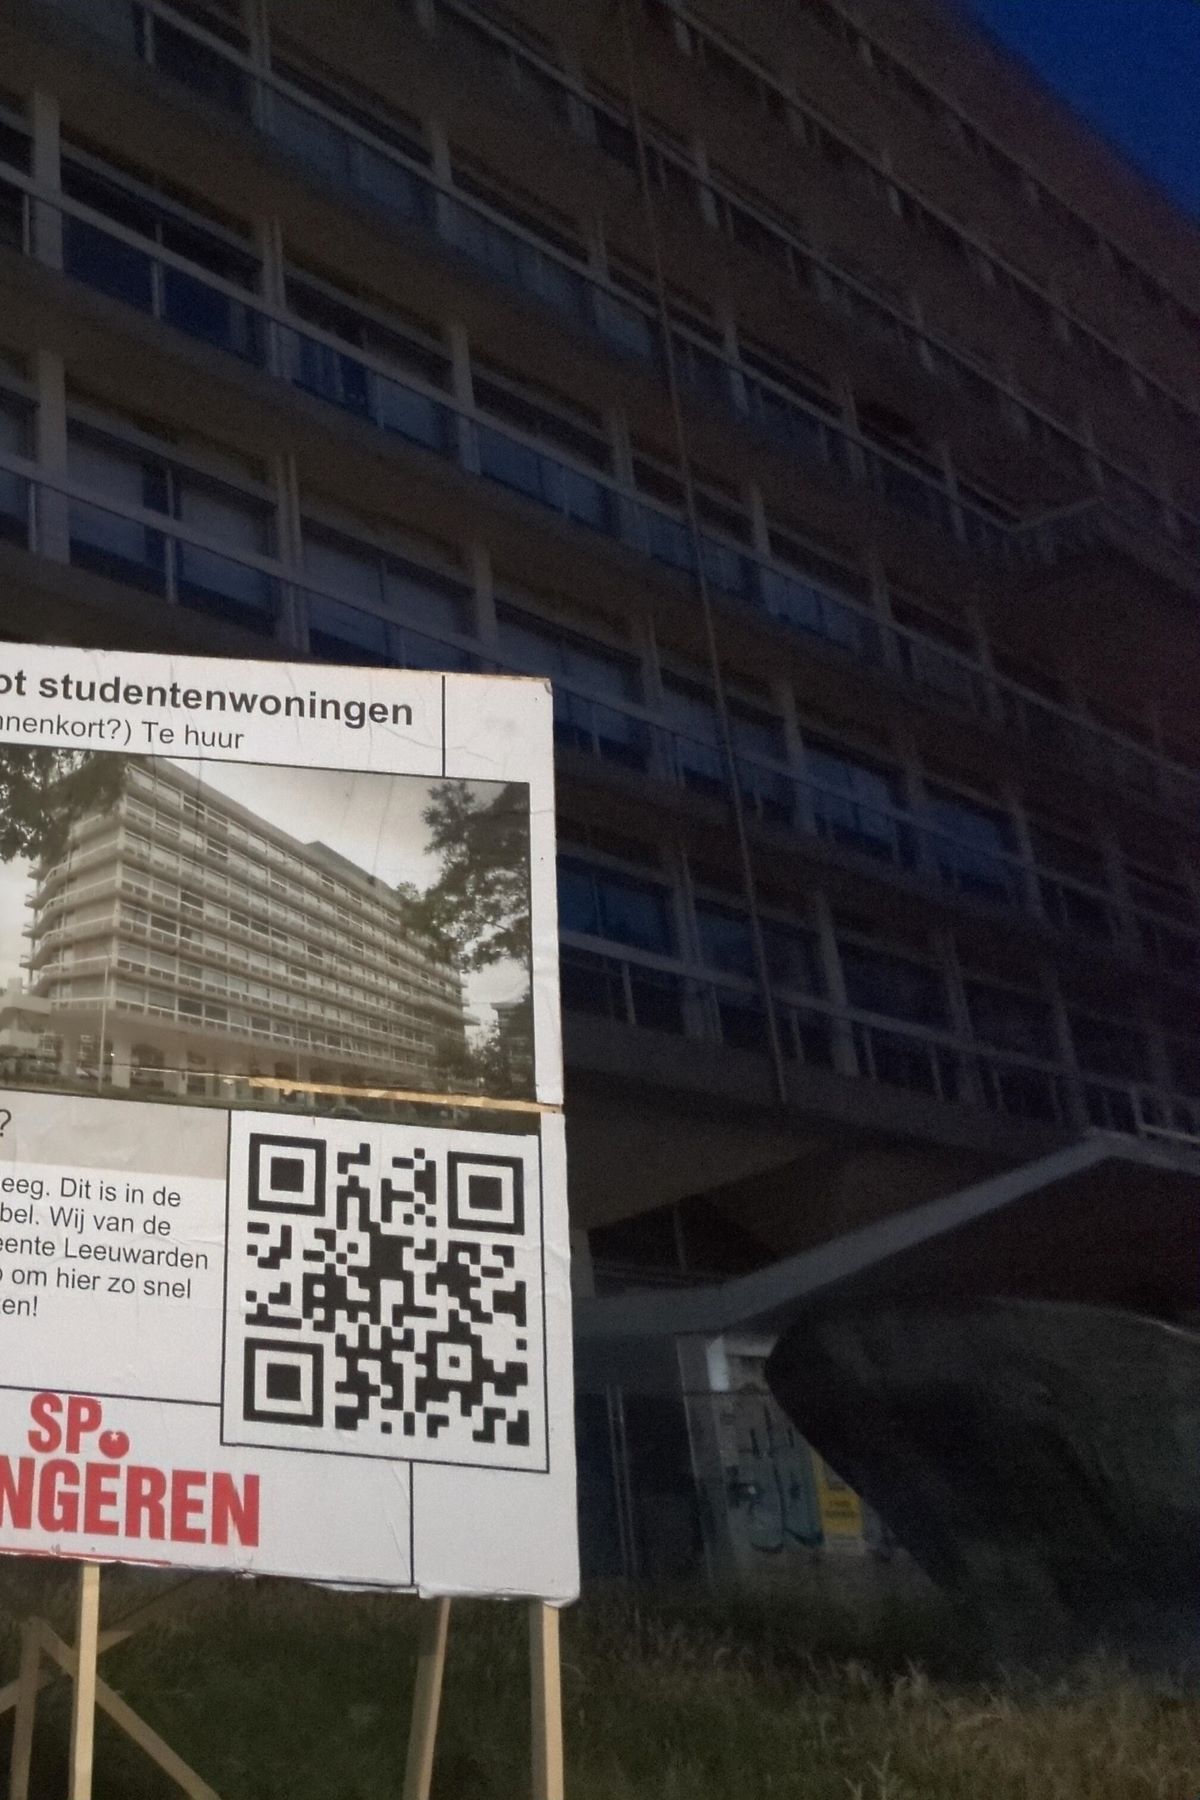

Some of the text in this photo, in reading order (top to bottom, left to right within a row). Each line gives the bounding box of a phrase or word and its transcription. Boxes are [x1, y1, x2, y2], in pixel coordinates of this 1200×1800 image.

[38, 673, 414, 730] studentenwoningen
[141, 720, 175, 745] Te
[184, 724, 245, 750] huur
[60, 1176, 92, 1200] Dit
[99, 1180, 117, 1202] is
[125, 1182, 144, 1205] in
[152, 1185, 181, 1208] de
[49, 1205, 85, 1235] Wij
[92, 1214, 134, 1233] van
[142, 1214, 171, 1237] de
[64, 1237, 208, 1273] Leeuwarden
[11, 1268, 48, 1287] om
[56, 1266, 102, 1291] hier
[107, 1276, 136, 1295] zo
[143, 1278, 191, 1299] snel
